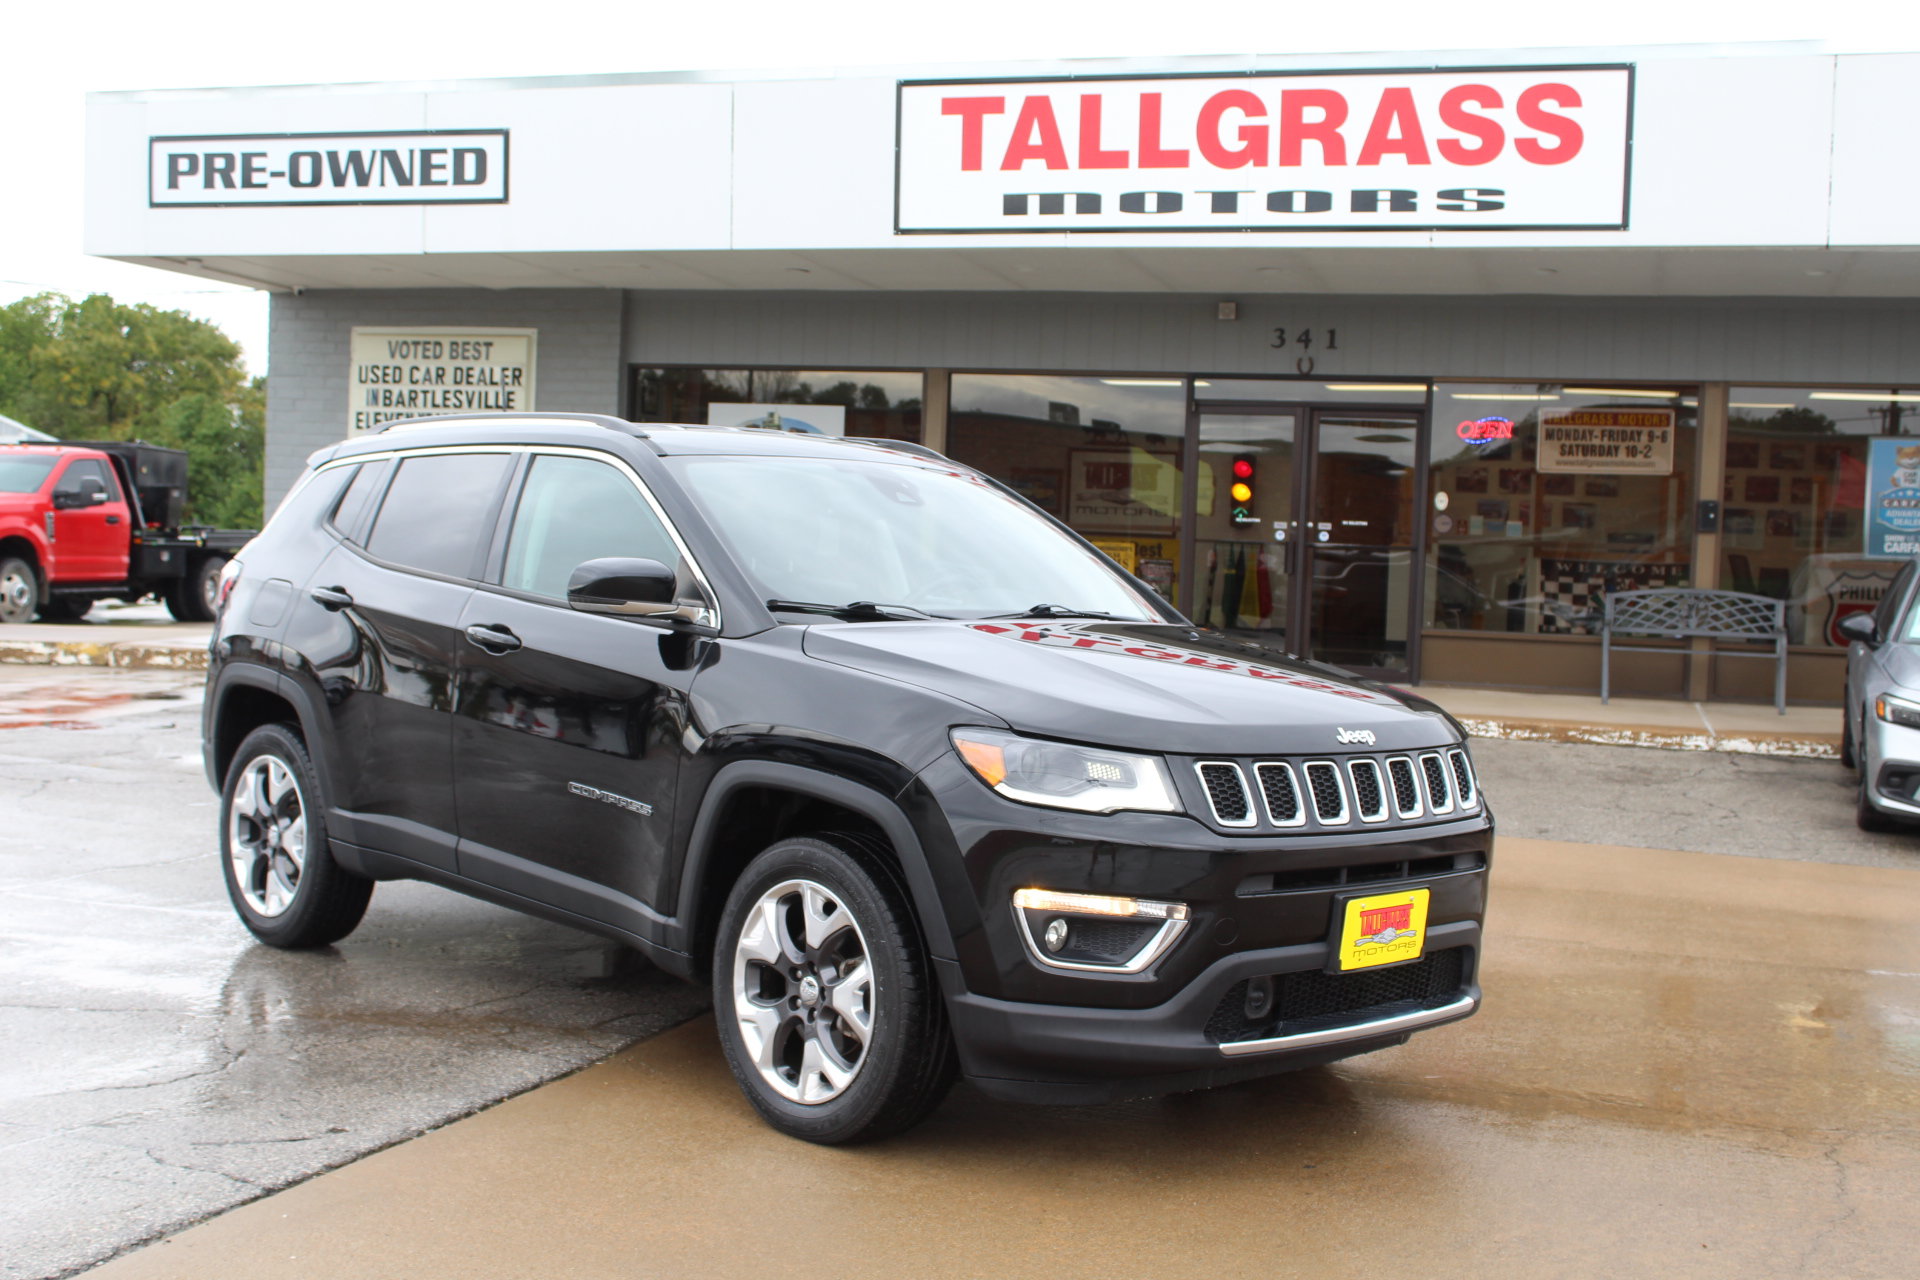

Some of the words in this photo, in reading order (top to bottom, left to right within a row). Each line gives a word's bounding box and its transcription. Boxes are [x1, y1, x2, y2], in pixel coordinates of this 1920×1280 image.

[941, 83, 1584, 172] TALLGRASS
[167, 147, 488, 190] PRE-OWNED
[1003, 188, 1506, 216] MOTORS
[387, 340, 444, 360] VOTED
[449, 341, 494, 360] BEST
[1270, 327, 1338, 352] 341
[358, 365, 402, 384] USED
[409, 366, 445, 385] CAR
[453, 366, 523, 386] DEALER
[383, 389, 516, 410] BARTLESVILLE
[1456, 419, 1514, 440] OPEN
[1618, 413, 1668, 426] MOTORS
[1560, 444, 1620, 458] SATURDAY
[1625, 445, 1652, 459] 10-2
[1336, 727, 1376, 746] Jeep
[568, 781, 653, 816] COMPASS
[1353, 941, 1417, 958] MOTORS
